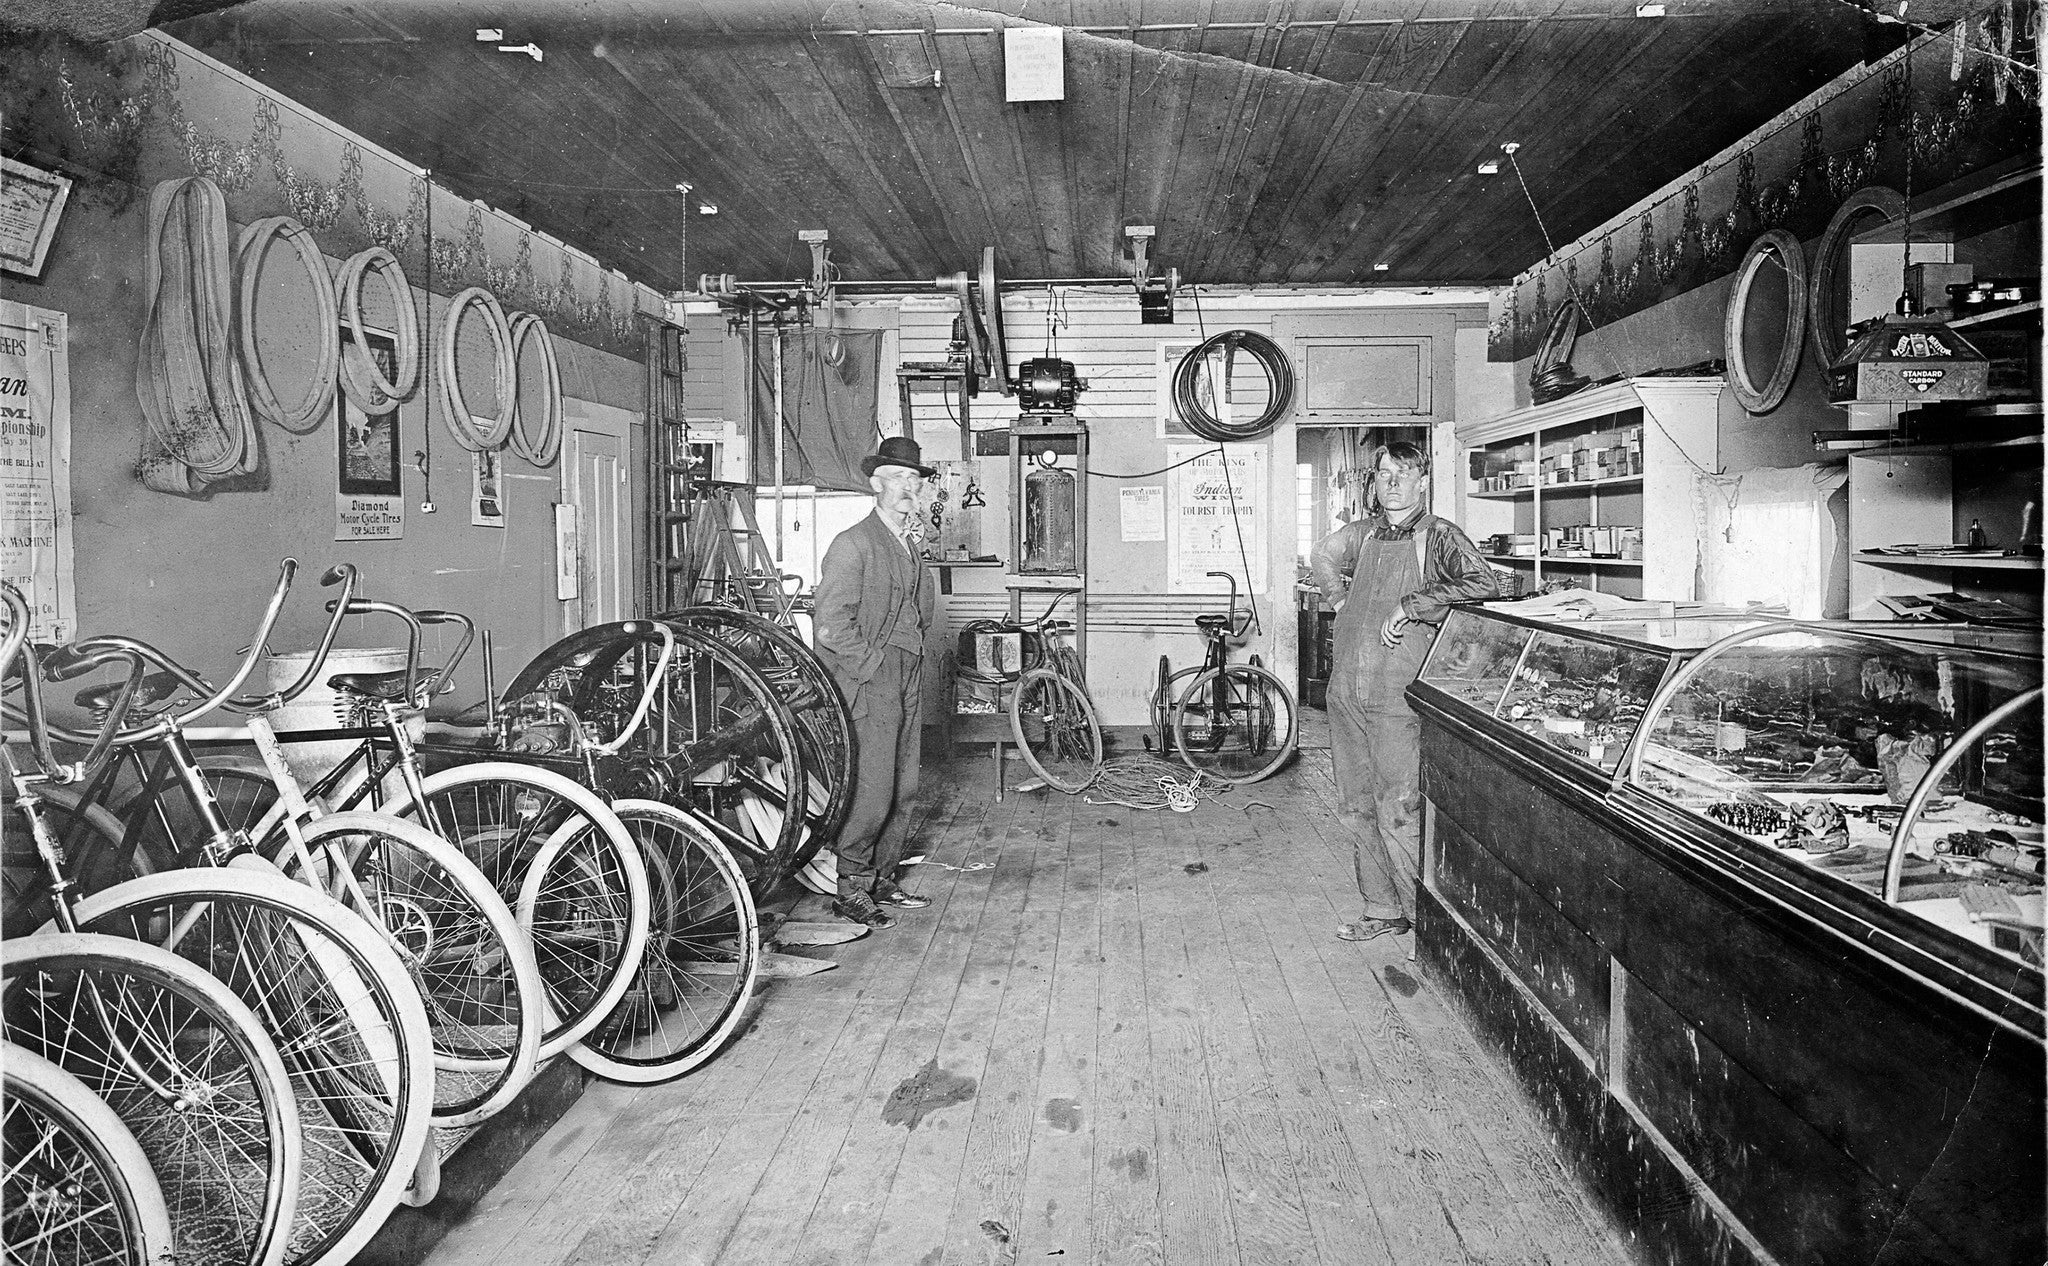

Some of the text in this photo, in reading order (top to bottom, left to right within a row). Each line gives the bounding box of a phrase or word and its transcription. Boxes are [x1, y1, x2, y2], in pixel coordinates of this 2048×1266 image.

[1191, 458, 1246, 467] THE KING
[1193, 481, 1244, 495] Indian
[351, 500, 389, 511] Diamond
[1182, 506, 1216, 516] TOURIST
[340, 513, 360, 524] Motor
[361, 512, 380, 526] Cycle
